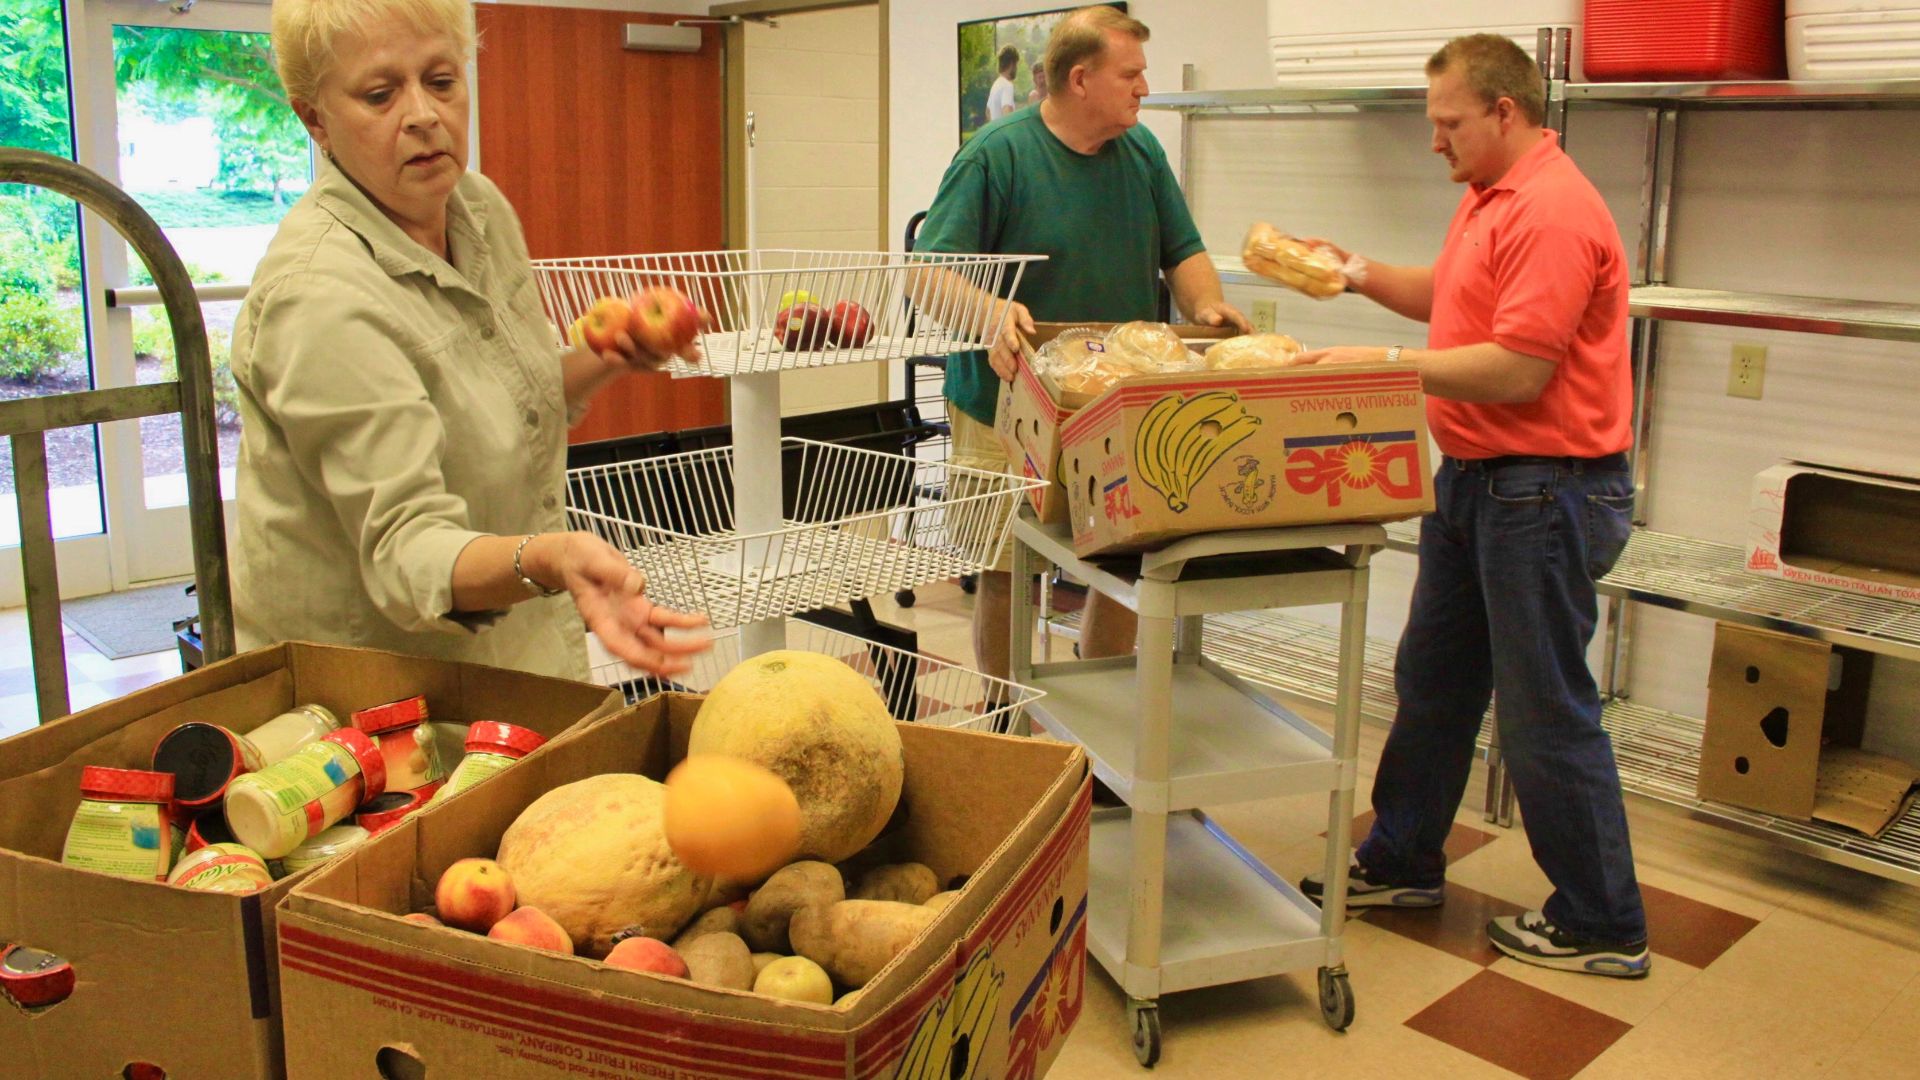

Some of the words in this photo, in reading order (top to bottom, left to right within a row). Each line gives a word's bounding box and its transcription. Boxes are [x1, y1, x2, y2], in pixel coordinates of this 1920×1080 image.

[1289, 396, 1353, 413] BANANAS
[1355, 393, 1417, 409] PREMIUM
[1284, 441, 1423, 507] Dole
[1783, 566, 1811, 581] OVEN
[1814, 574, 1849, 588] BAKED
[1850, 582, 1893, 597] ITALIAN
[459, 1020, 514, 1041] WESTLAKE
[515, 1031, 583, 1059] COMPANY,
[586, 1050, 626, 1070] FRUIT
[629, 1060, 675, 1080] FRESH
